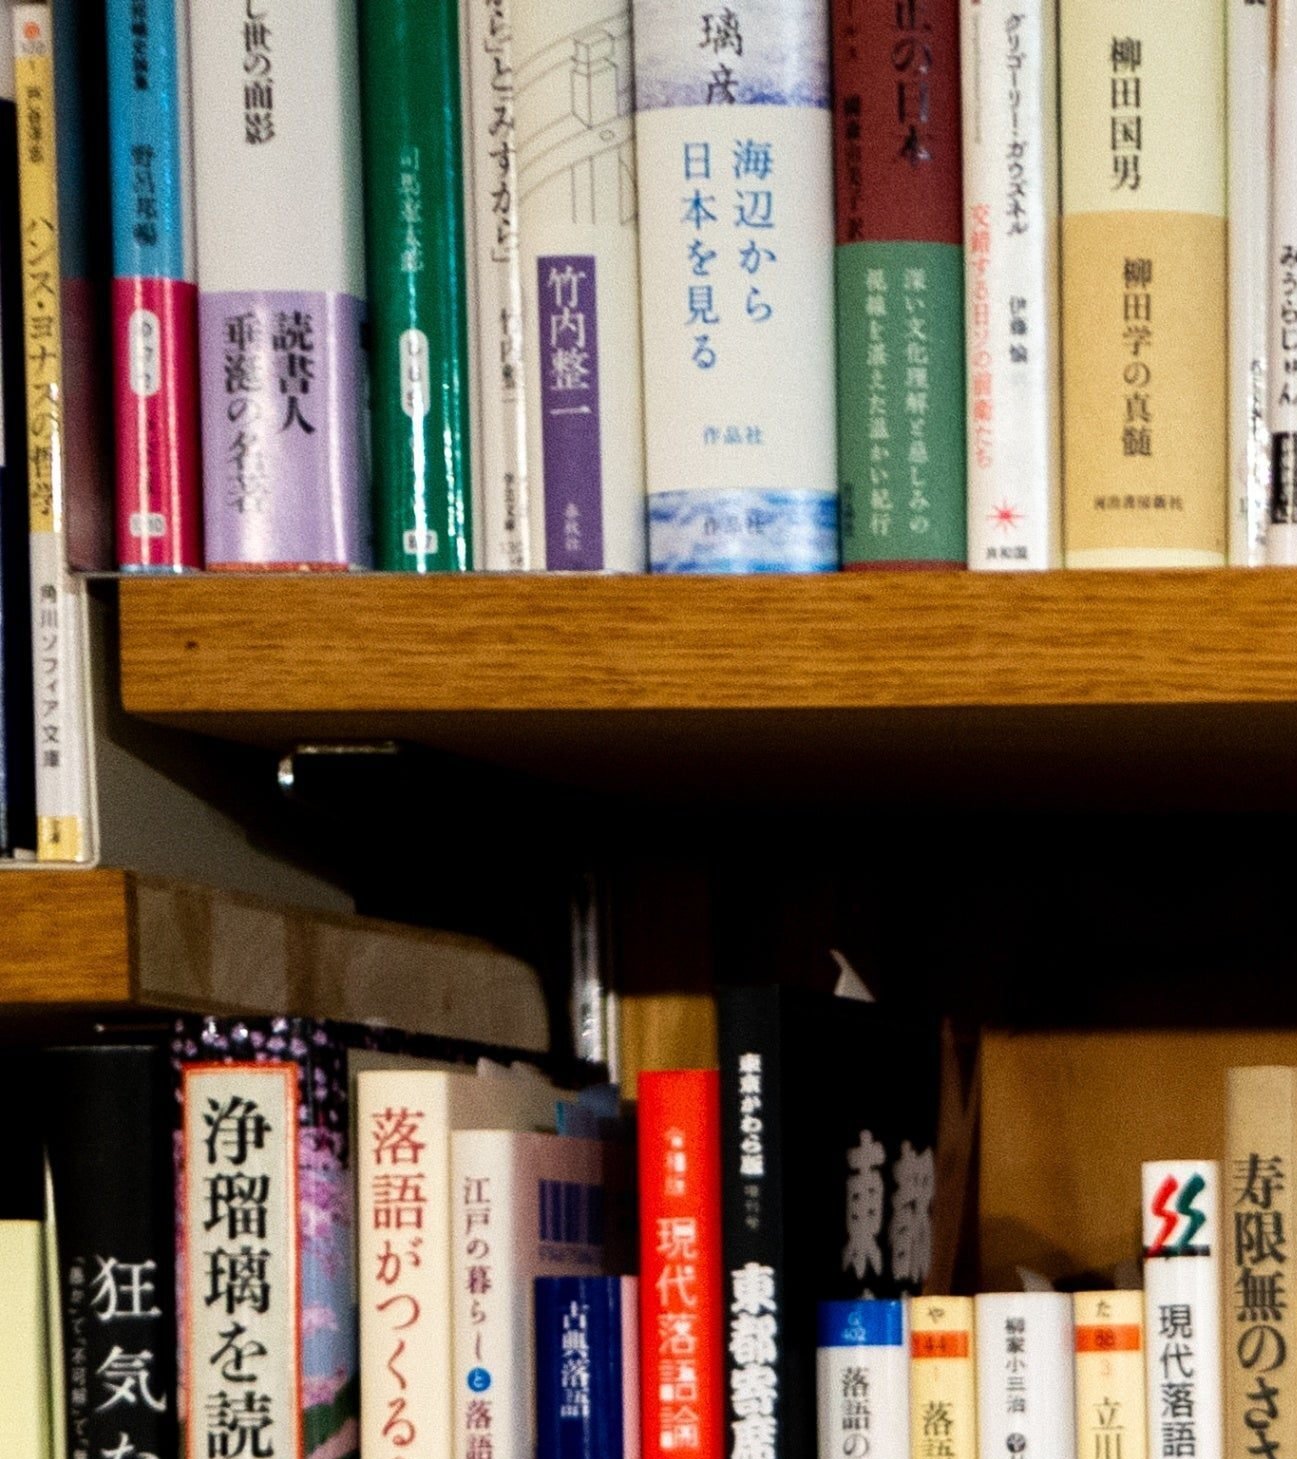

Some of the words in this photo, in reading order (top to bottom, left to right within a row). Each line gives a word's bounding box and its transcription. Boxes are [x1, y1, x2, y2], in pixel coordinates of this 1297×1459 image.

[1110, 36, 1143, 191] 柳田国男
[680, 140, 721, 372] 日本を見る
[732, 138, 777, 325] 海辺から
[271, 311, 316, 436] 読書人
[546, 266, 592, 416] 竹内整一
[1122, 257, 1153, 459] 柳田学の真髄
[702, 425, 764, 447] 作品社
[560, 1300, 592, 1419] 古典落語
[656, 1216, 701, 1451] 現代落語論
[1003, 1317, 1027, 1415] 柳家小三治
